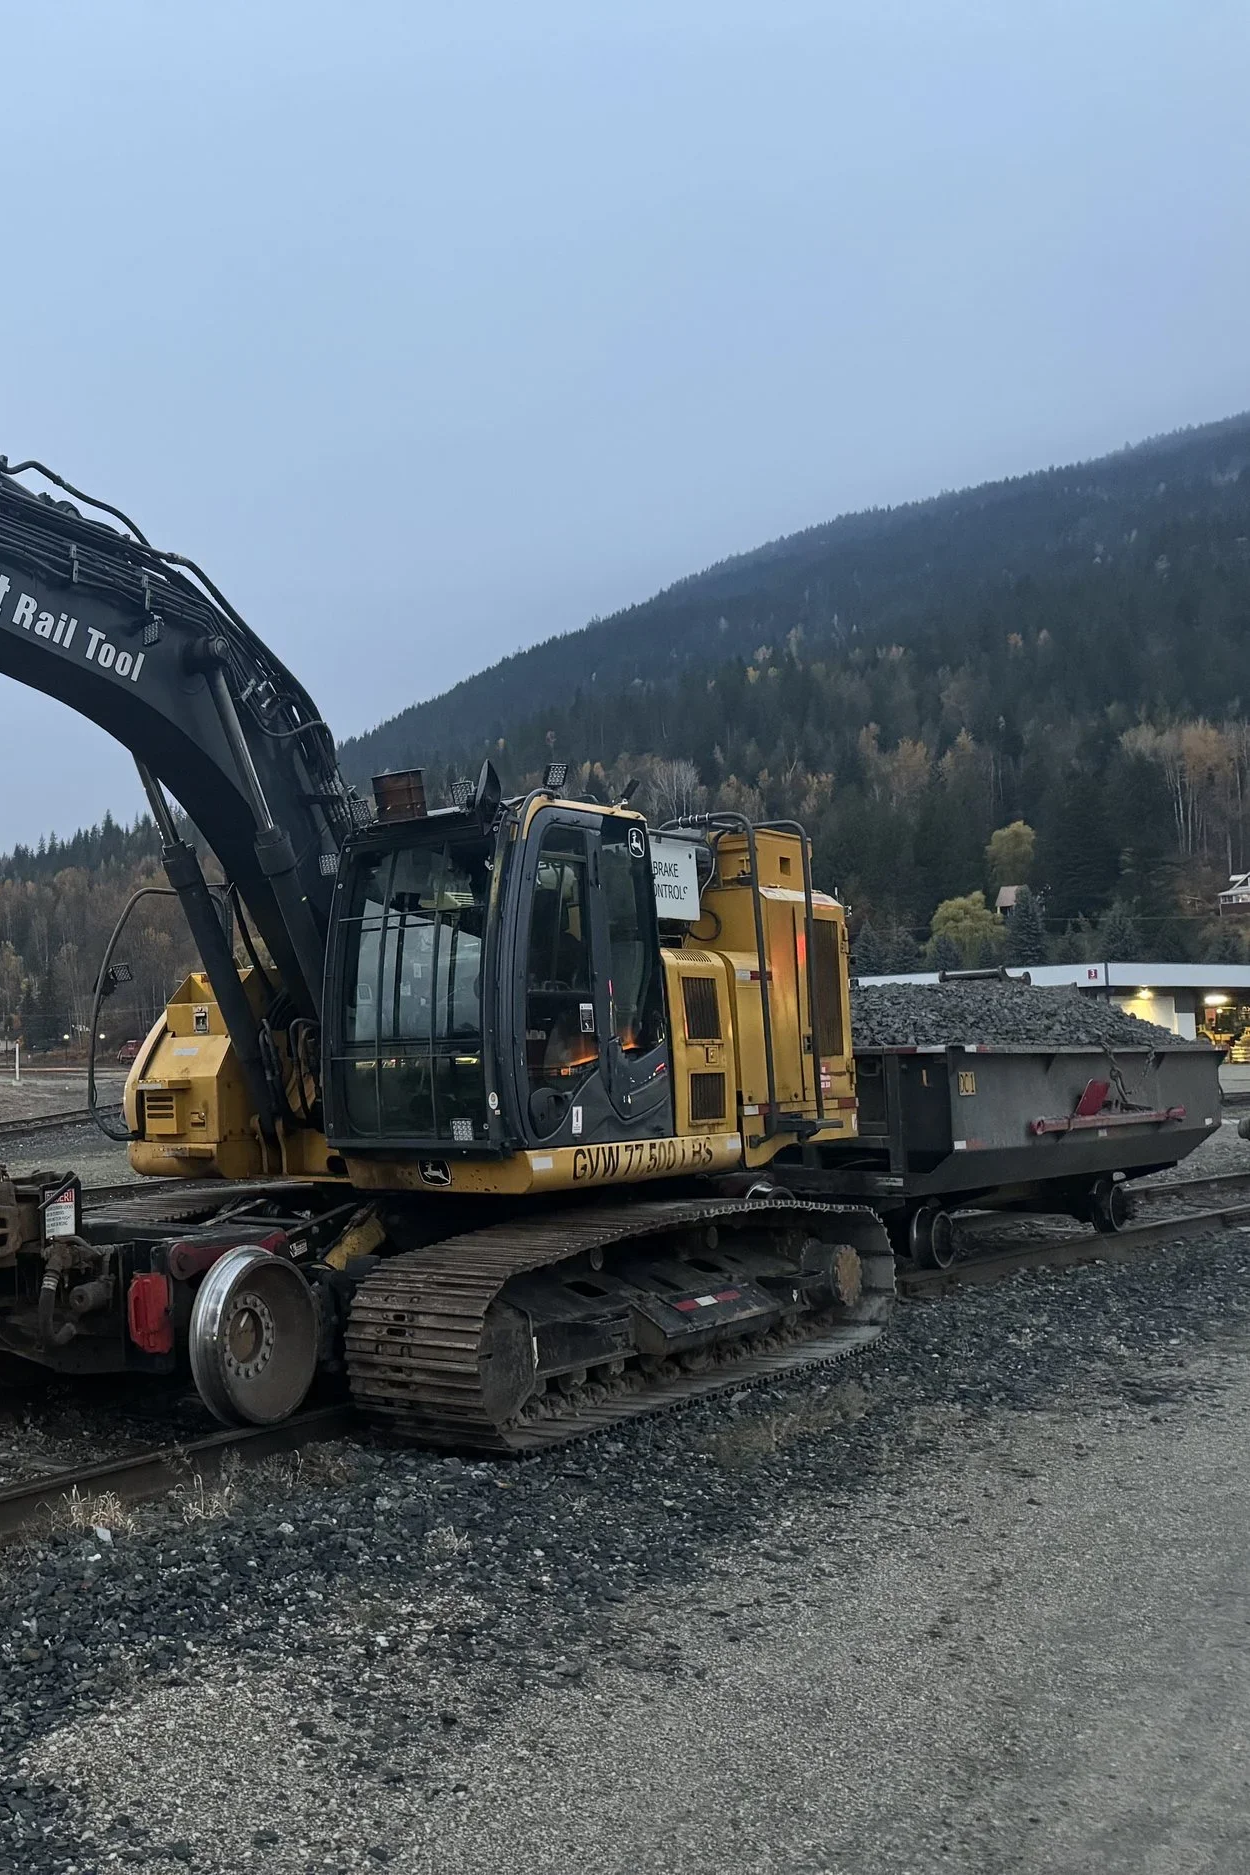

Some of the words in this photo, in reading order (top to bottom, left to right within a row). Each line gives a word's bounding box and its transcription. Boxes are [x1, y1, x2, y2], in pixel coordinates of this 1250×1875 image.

[12, 593, 78, 649] Rail
[85, 627, 145, 682] Tool
[653, 861, 678, 878] BRAKE
[654, 884, 688, 900] ONTROLS
[574, 1146, 620, 1180] GVW
